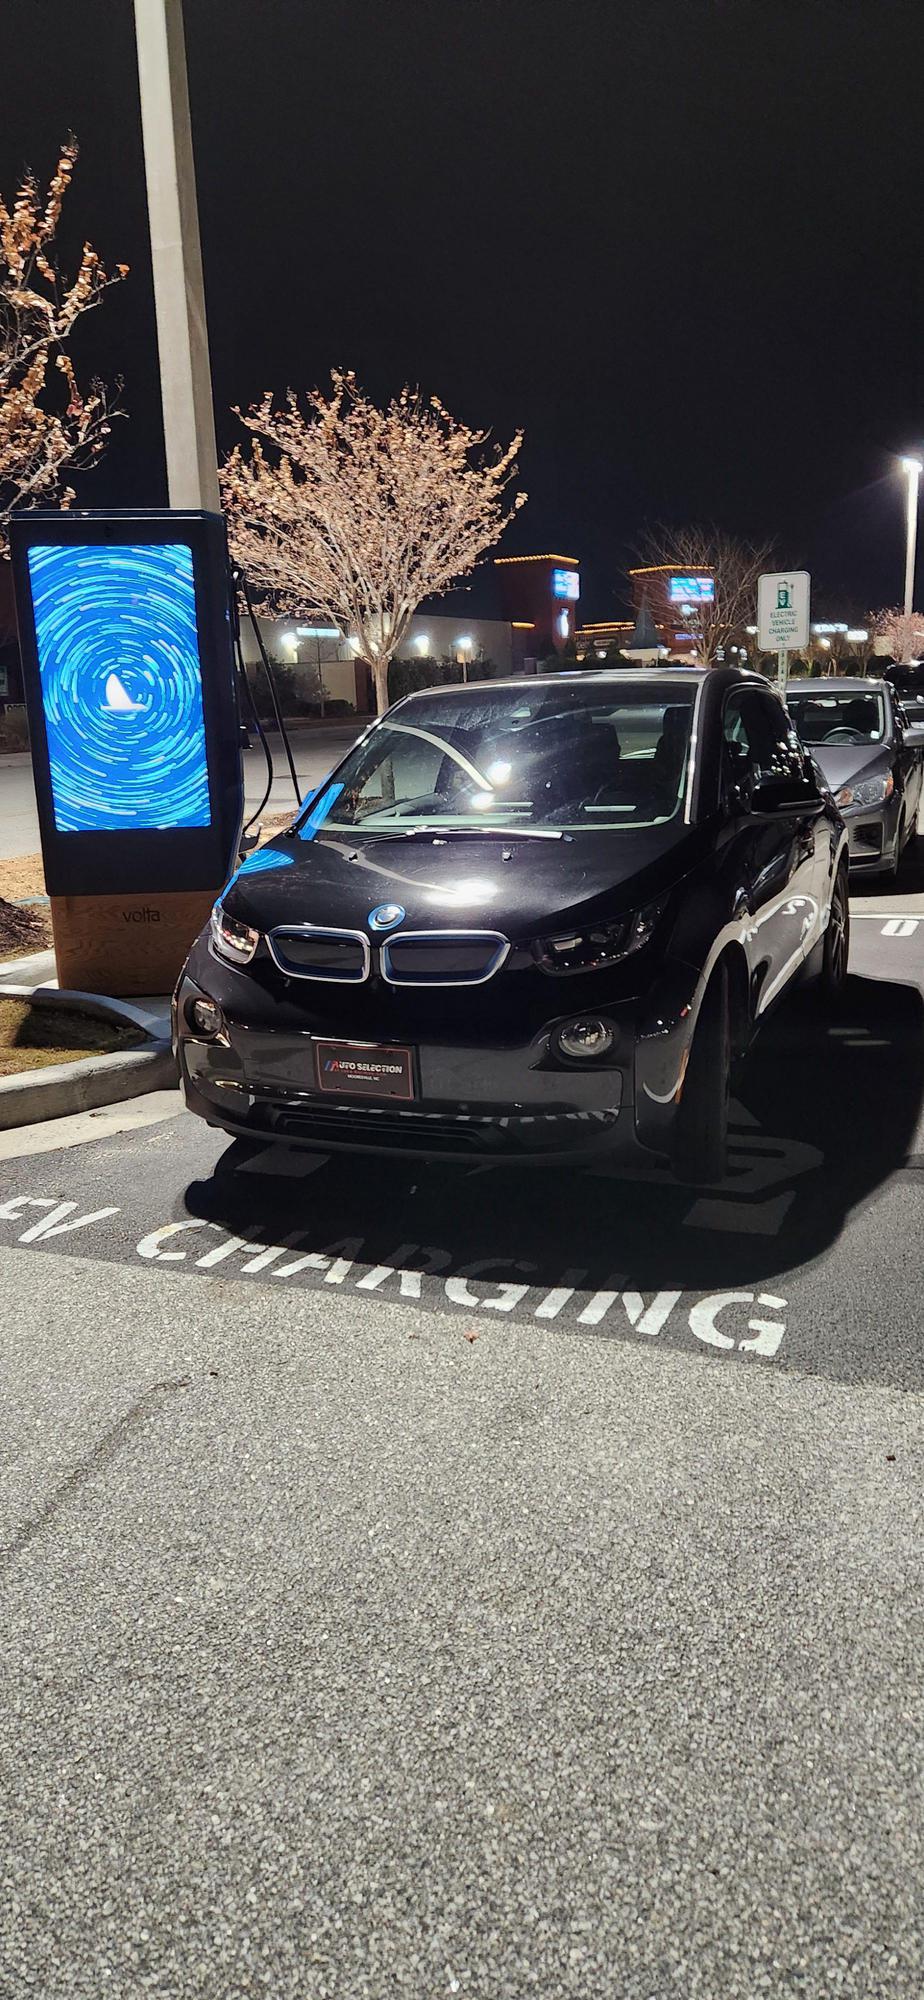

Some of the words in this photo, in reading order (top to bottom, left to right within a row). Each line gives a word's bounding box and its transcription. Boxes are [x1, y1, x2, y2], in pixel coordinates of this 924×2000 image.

[770, 610, 798, 618] ELECTRIC
[769, 626, 799, 634] CHARGING
[122, 907, 161, 922] volta
[357, 1062, 403, 1074] SELECTION
[136, 1219, 788, 1356] CHARGING
